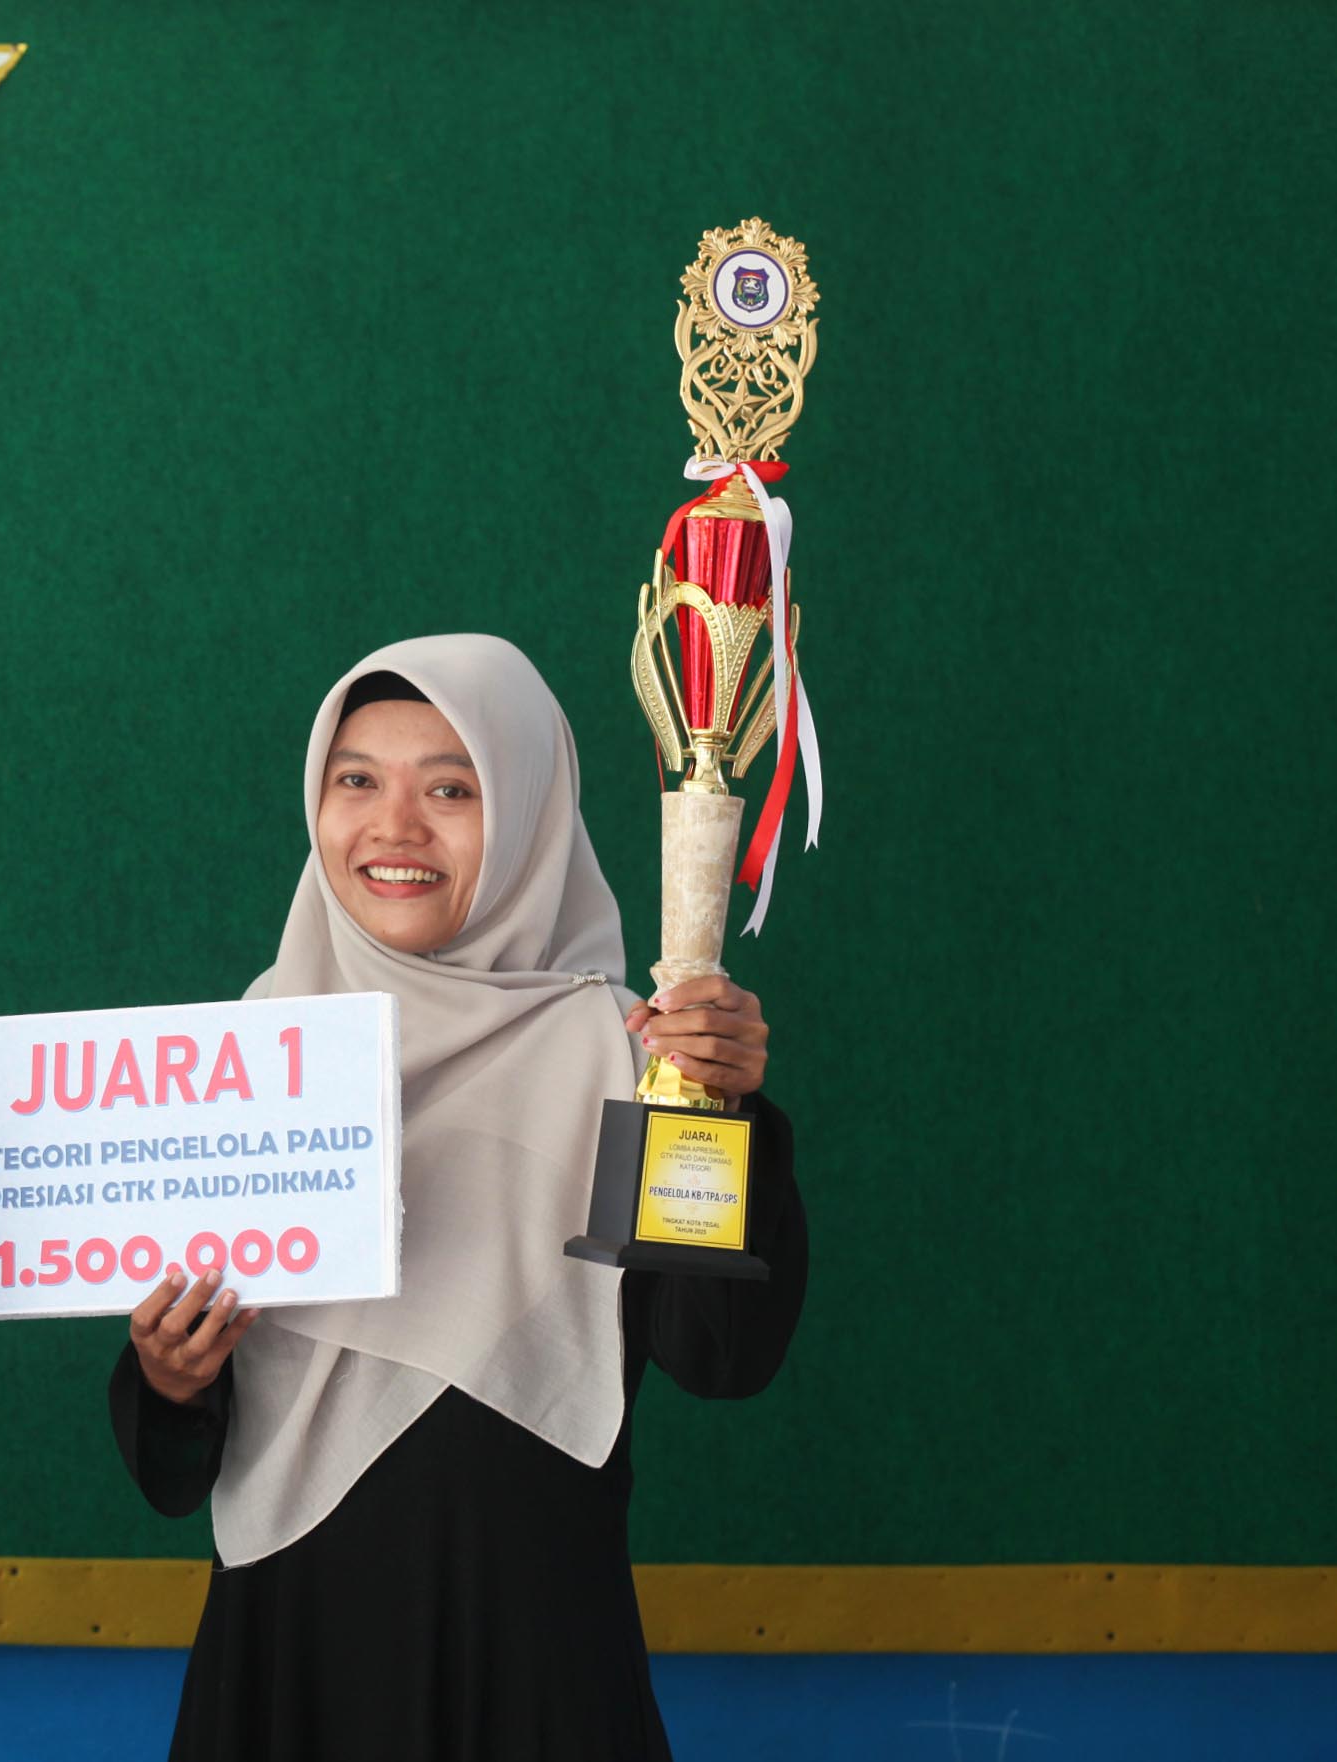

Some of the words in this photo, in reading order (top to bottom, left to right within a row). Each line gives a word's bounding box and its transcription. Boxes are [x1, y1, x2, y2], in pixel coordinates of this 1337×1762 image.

[10, 1031, 255, 1116] JUARA
[279, 1026, 303, 1098] 1
[679, 1130, 712, 1142] JUARA
[101, 1131, 279, 1165] PENGELOLA
[287, 1125, 373, 1154] PAUD
[680, 1163, 711, 1172] KATEGORI
[102, 1179, 155, 1203] GTK
[163, 1167, 356, 1201] PAUD/DIKMAS
[649, 1186, 689, 1199] PENGELOLA
[691, 1190, 738, 1204] KB/TPA/SPS
[663, 1217, 685, 1225] TINGKAT
[703, 1221, 720, 1229] TEGAL
[675, 1226, 693, 1234] TAHUN
